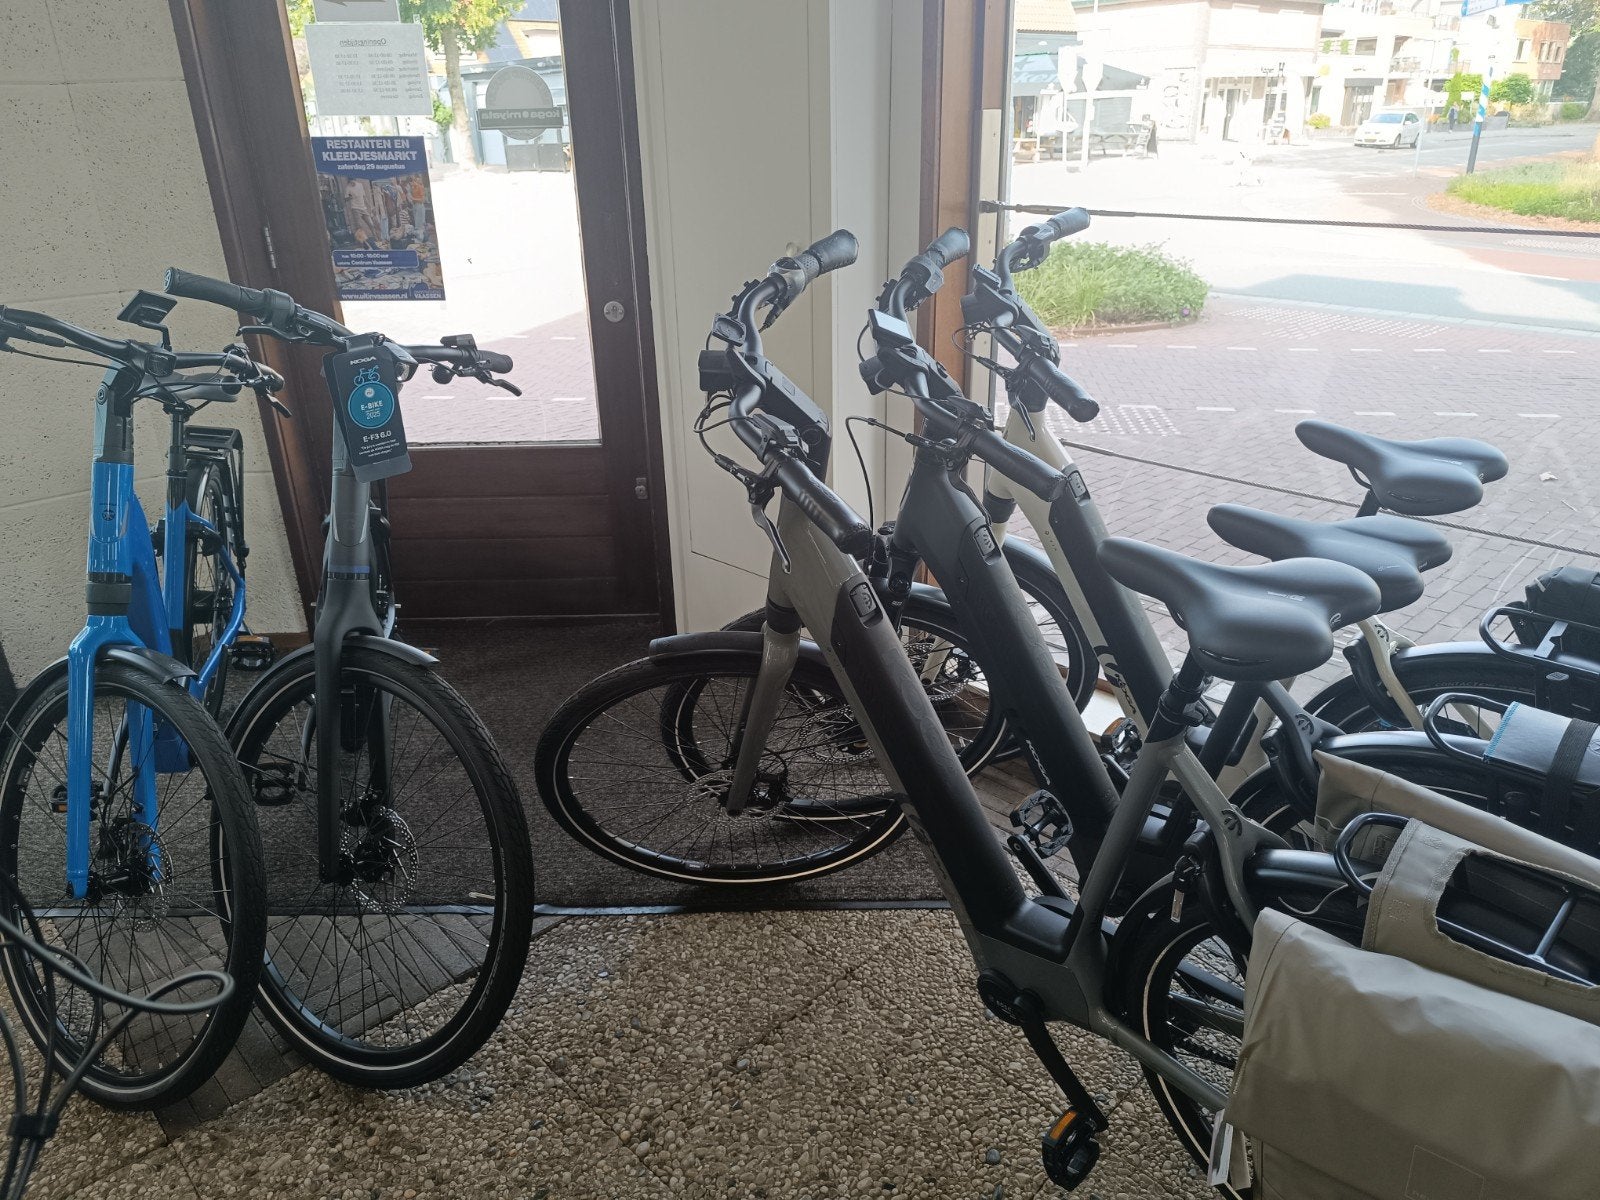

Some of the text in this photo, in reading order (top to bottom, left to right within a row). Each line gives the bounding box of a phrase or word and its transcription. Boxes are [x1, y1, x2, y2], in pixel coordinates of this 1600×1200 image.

[326, 139, 410, 149] RESTANTEN EN
[322, 151, 418, 162] KLEEDJESMARKT
[337, 163, 366, 171] zaterdag
[360, 400, 384, 411] E-BIKE
[363, 430, 392, 443] E-F3 6.0
